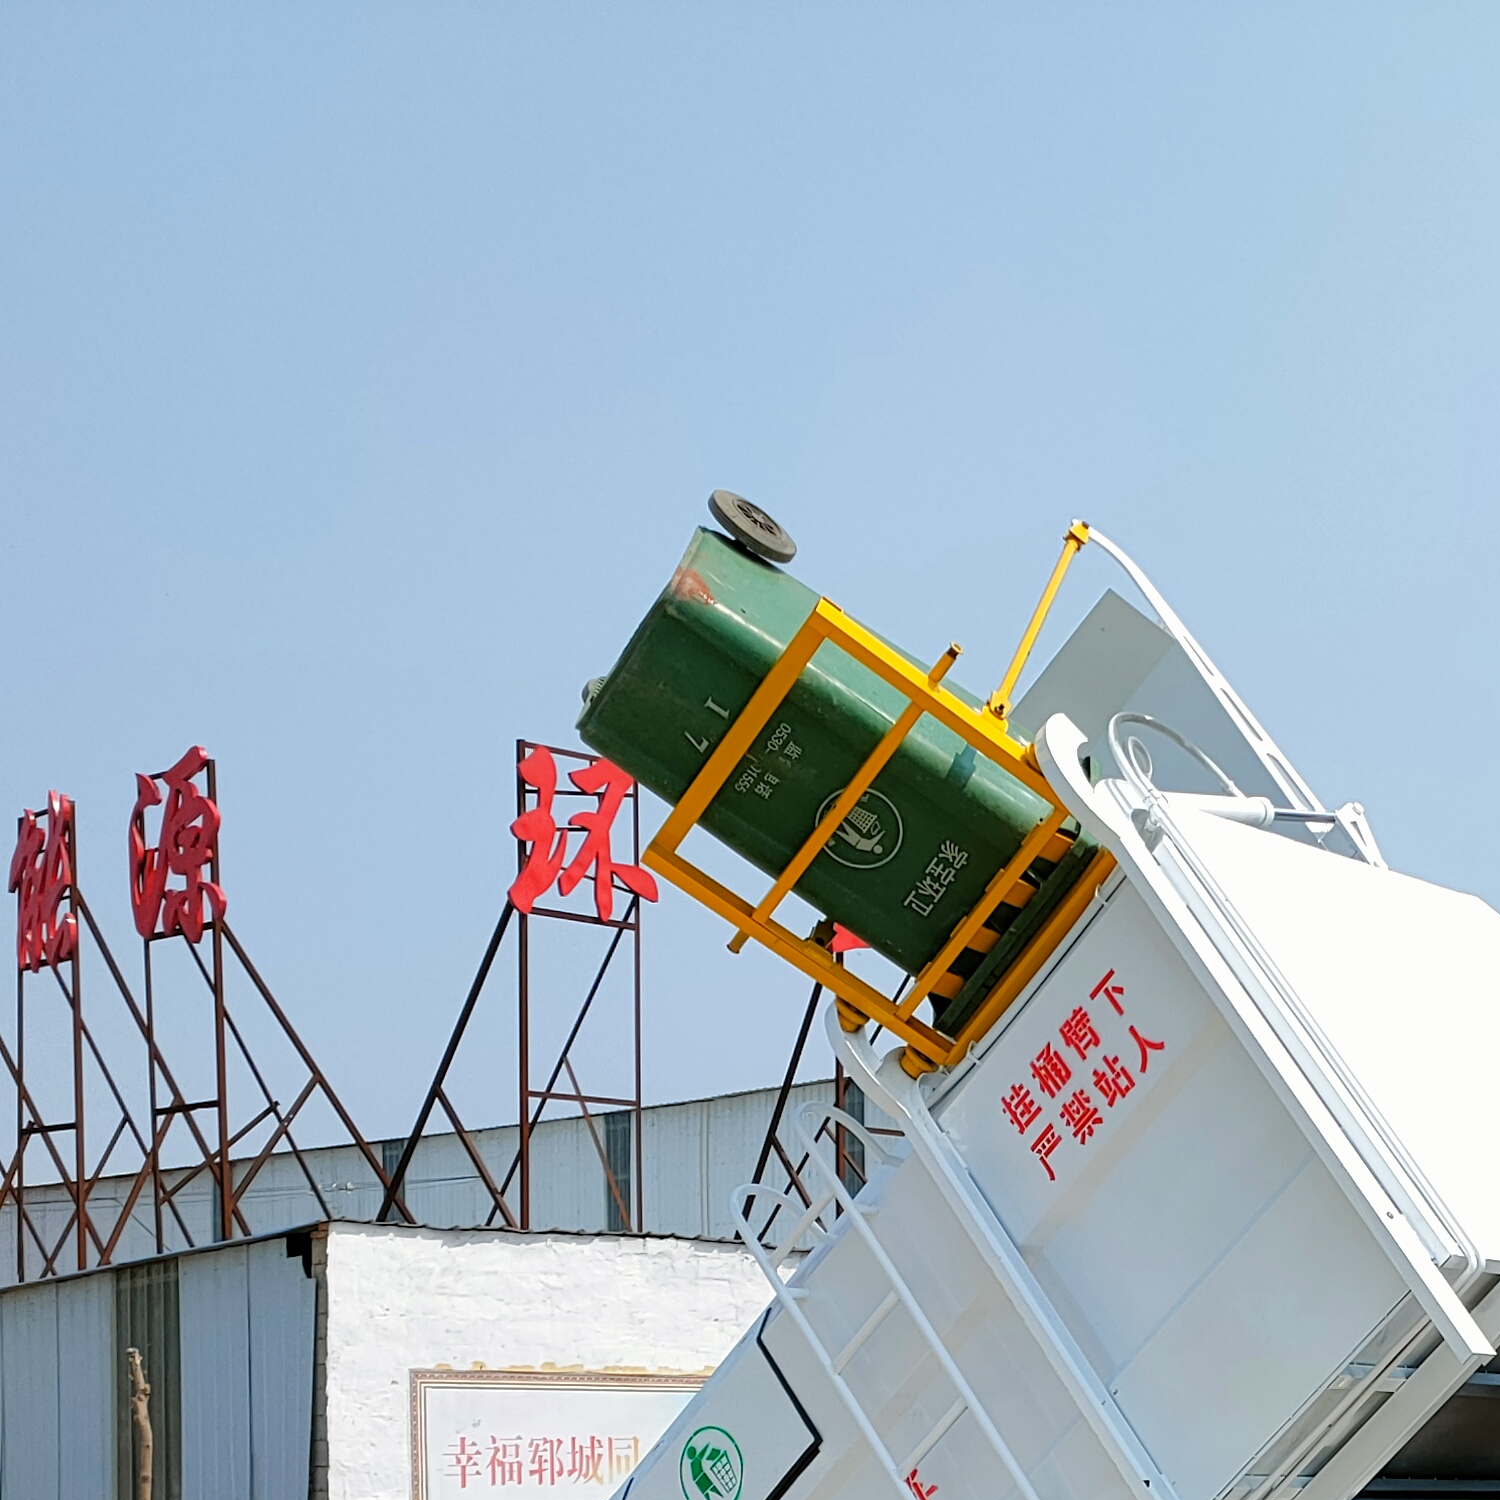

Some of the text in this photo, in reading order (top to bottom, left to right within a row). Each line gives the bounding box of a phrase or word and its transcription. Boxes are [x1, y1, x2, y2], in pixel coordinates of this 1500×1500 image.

[903, 840, 968, 917] 家宝环卫
[1001, 968, 1125, 1134] 挂桶臂下
[1030, 1025, 1165, 1181] 严禁站人
